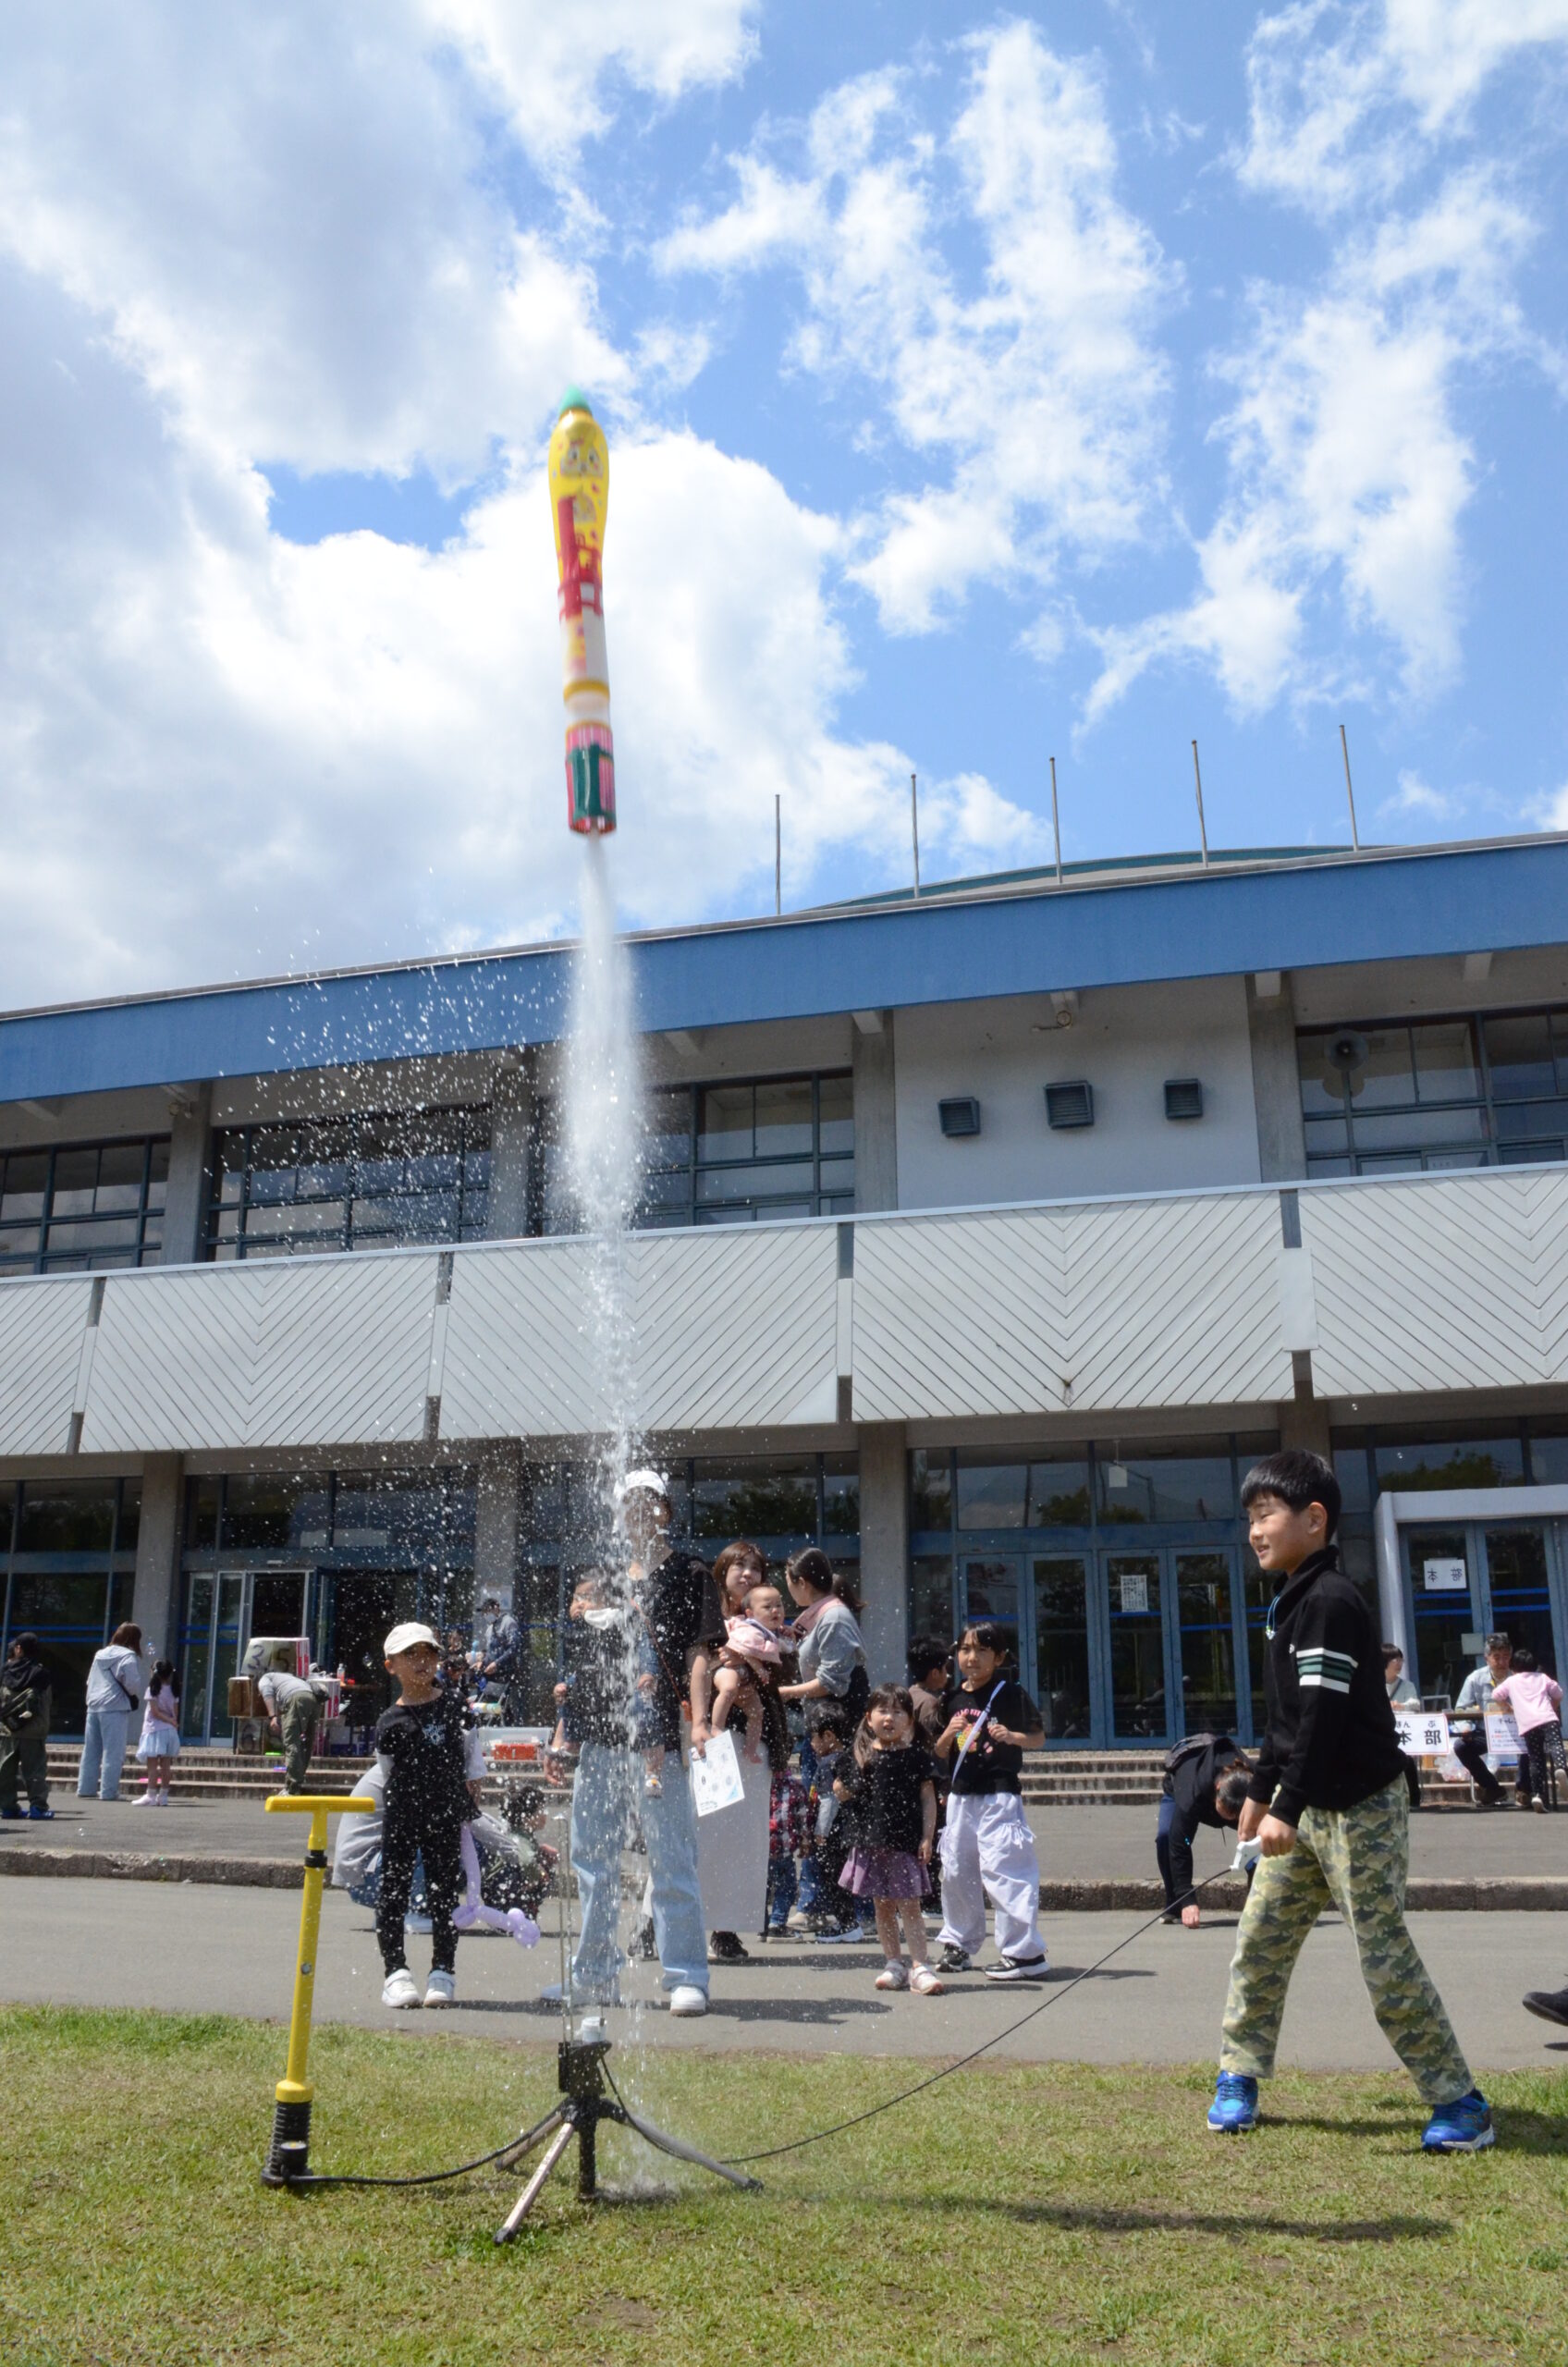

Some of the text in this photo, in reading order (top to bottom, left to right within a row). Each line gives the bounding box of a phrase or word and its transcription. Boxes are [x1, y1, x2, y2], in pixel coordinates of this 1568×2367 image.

[1427, 1567, 1463, 1582] 本部
[247, 1644, 264, 1670] 3
[1399, 1729, 1442, 1746] 本部
